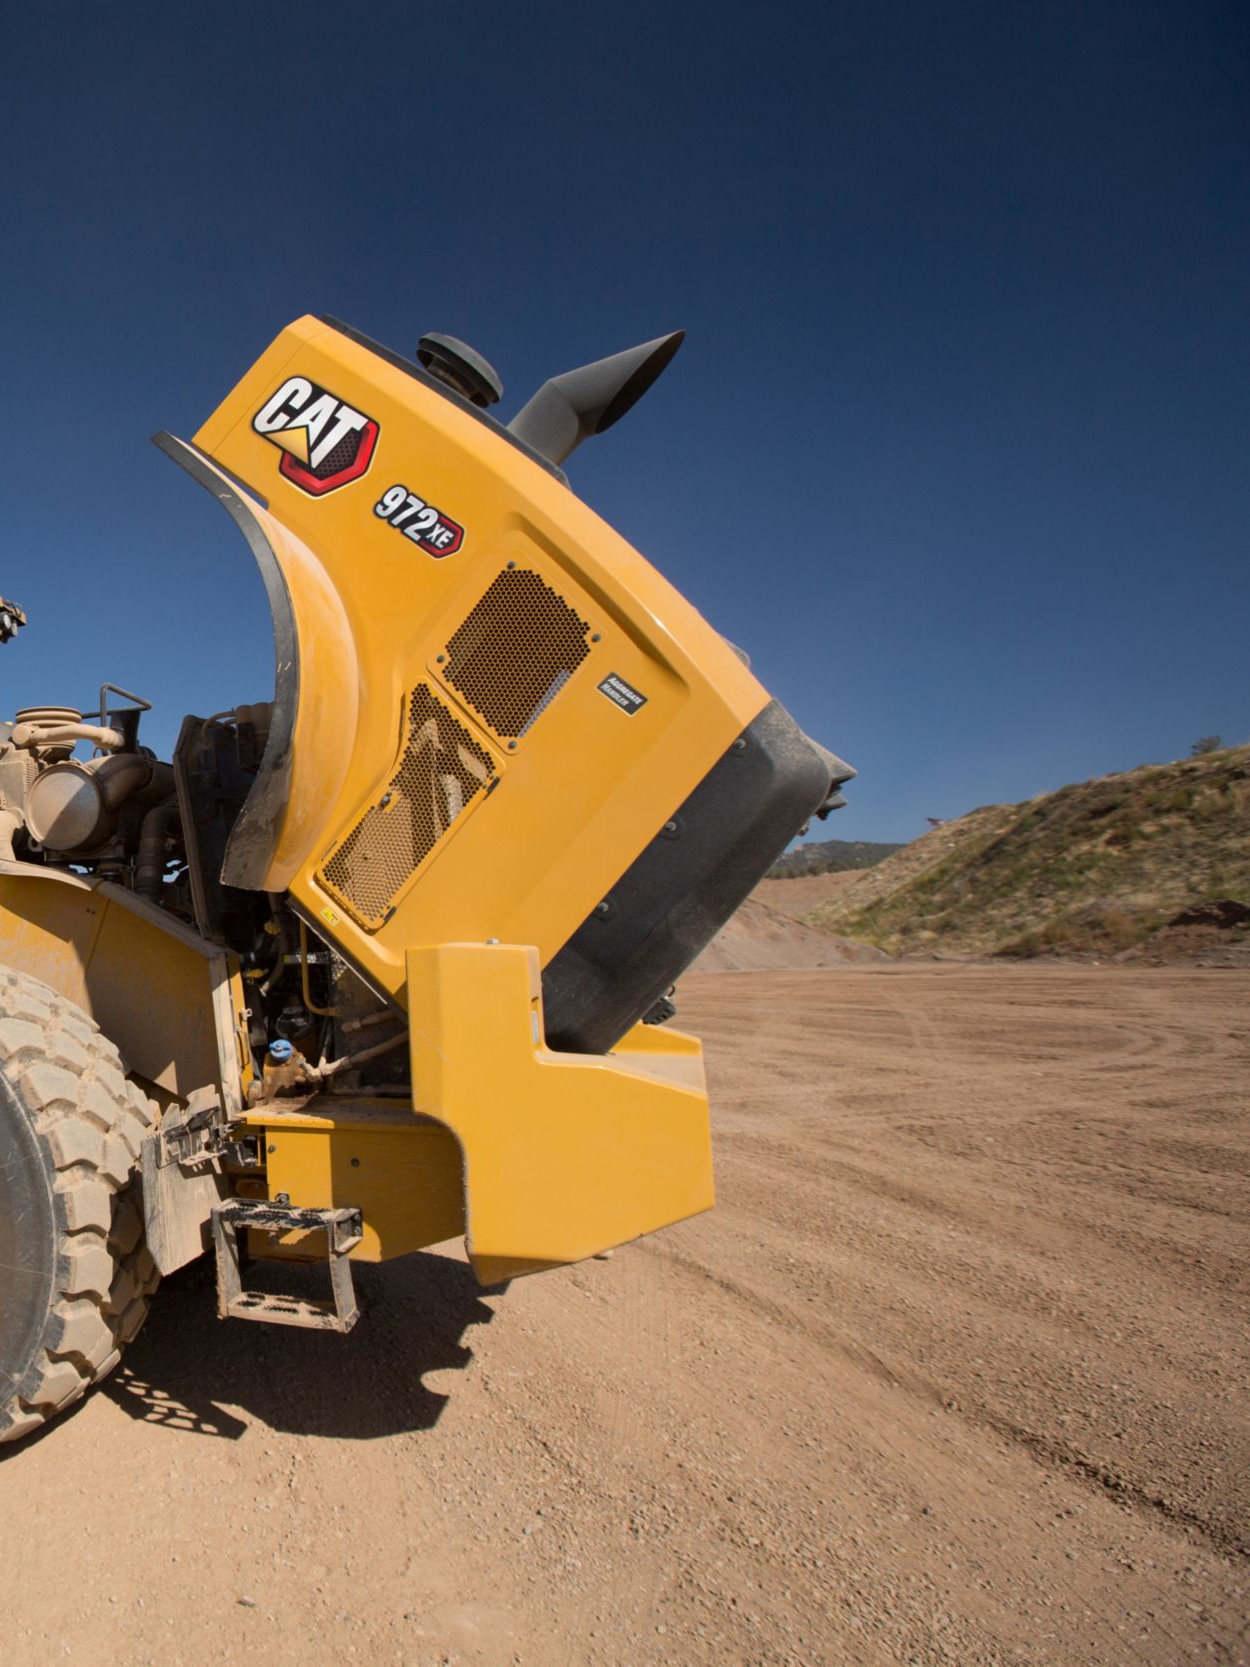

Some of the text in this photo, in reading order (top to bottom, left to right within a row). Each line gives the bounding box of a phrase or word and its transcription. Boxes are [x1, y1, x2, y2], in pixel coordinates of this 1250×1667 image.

[253, 377, 370, 469] CAT
[600, 683, 630, 707] HANDLER
[607, 676, 643, 705] AGGREGATE
